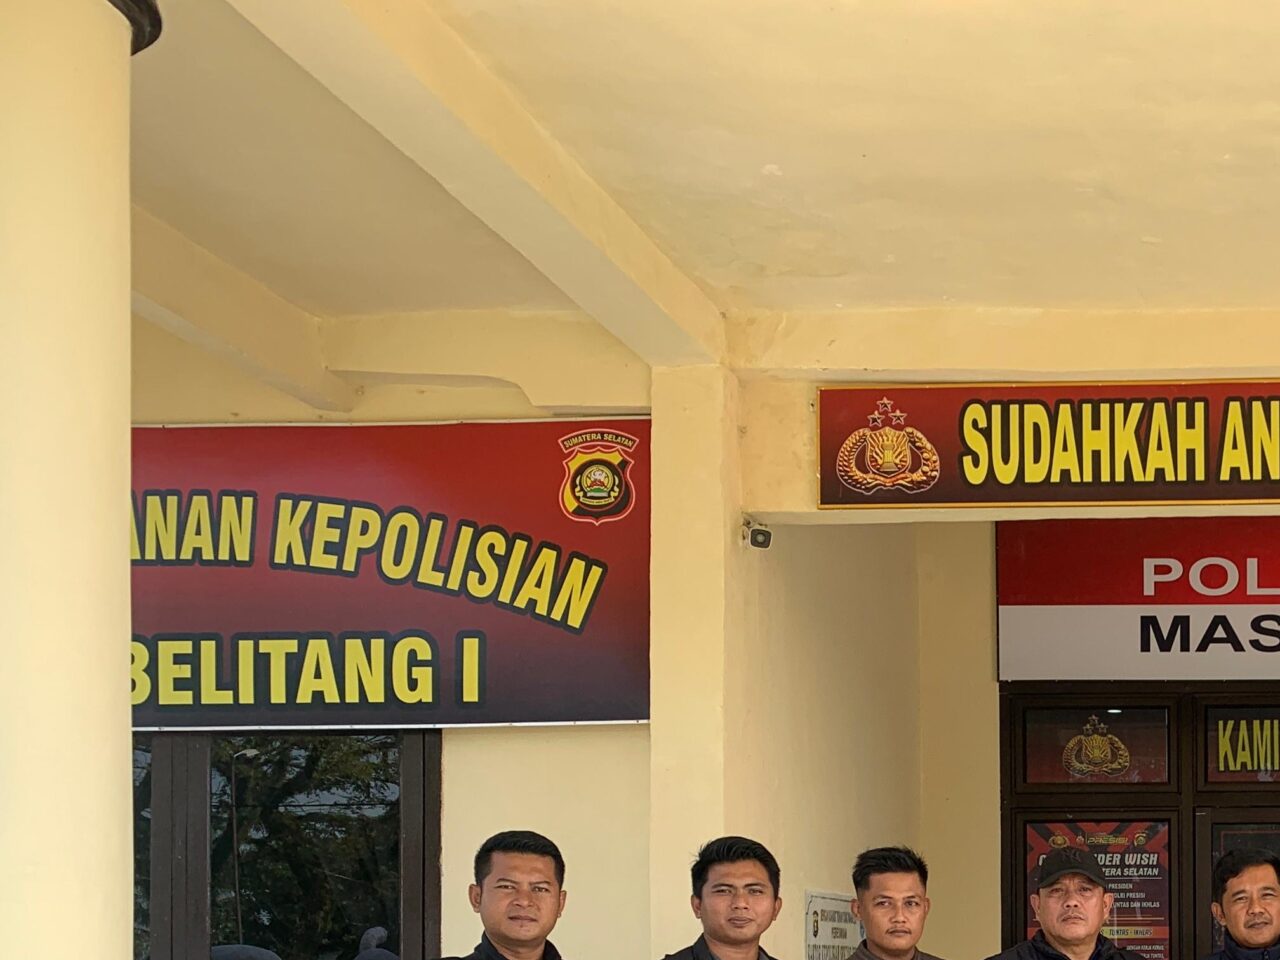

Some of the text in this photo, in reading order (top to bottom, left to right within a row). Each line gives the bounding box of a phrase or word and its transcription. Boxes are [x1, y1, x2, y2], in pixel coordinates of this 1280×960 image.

[563, 433, 634, 448] SUMATERA SELATAN
[962, 401, 1206, 486] SUDAHKAH
[131, 495, 603, 629] NAN KEPOLISIAN
[131, 637, 480, 705] BELITANG I
[1217, 719, 1280, 771] KAMI
[1123, 867, 1159, 877] SELATAN
[1124, 853, 1158, 866] WISH
